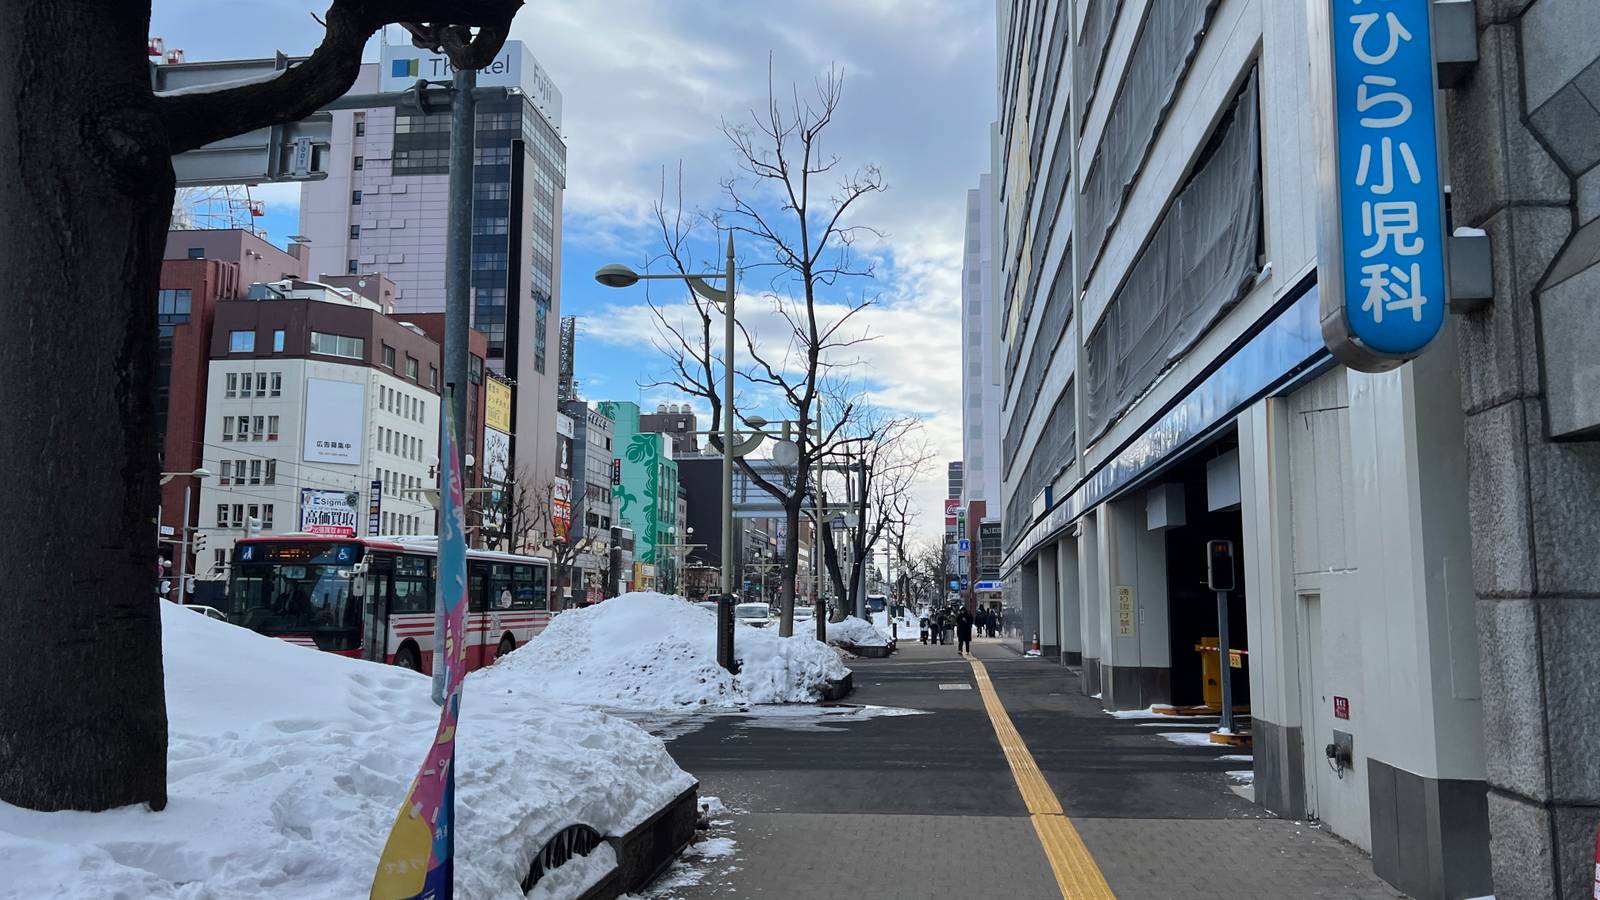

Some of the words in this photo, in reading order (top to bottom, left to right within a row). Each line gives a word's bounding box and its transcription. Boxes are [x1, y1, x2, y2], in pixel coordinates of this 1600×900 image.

[533, 63, 552, 104] Fujii
[1348, 0, 1427, 323] ひら小児科
[316, 441, 352, 450] 広告募集中
[305, 510, 354, 526] 高価買取
